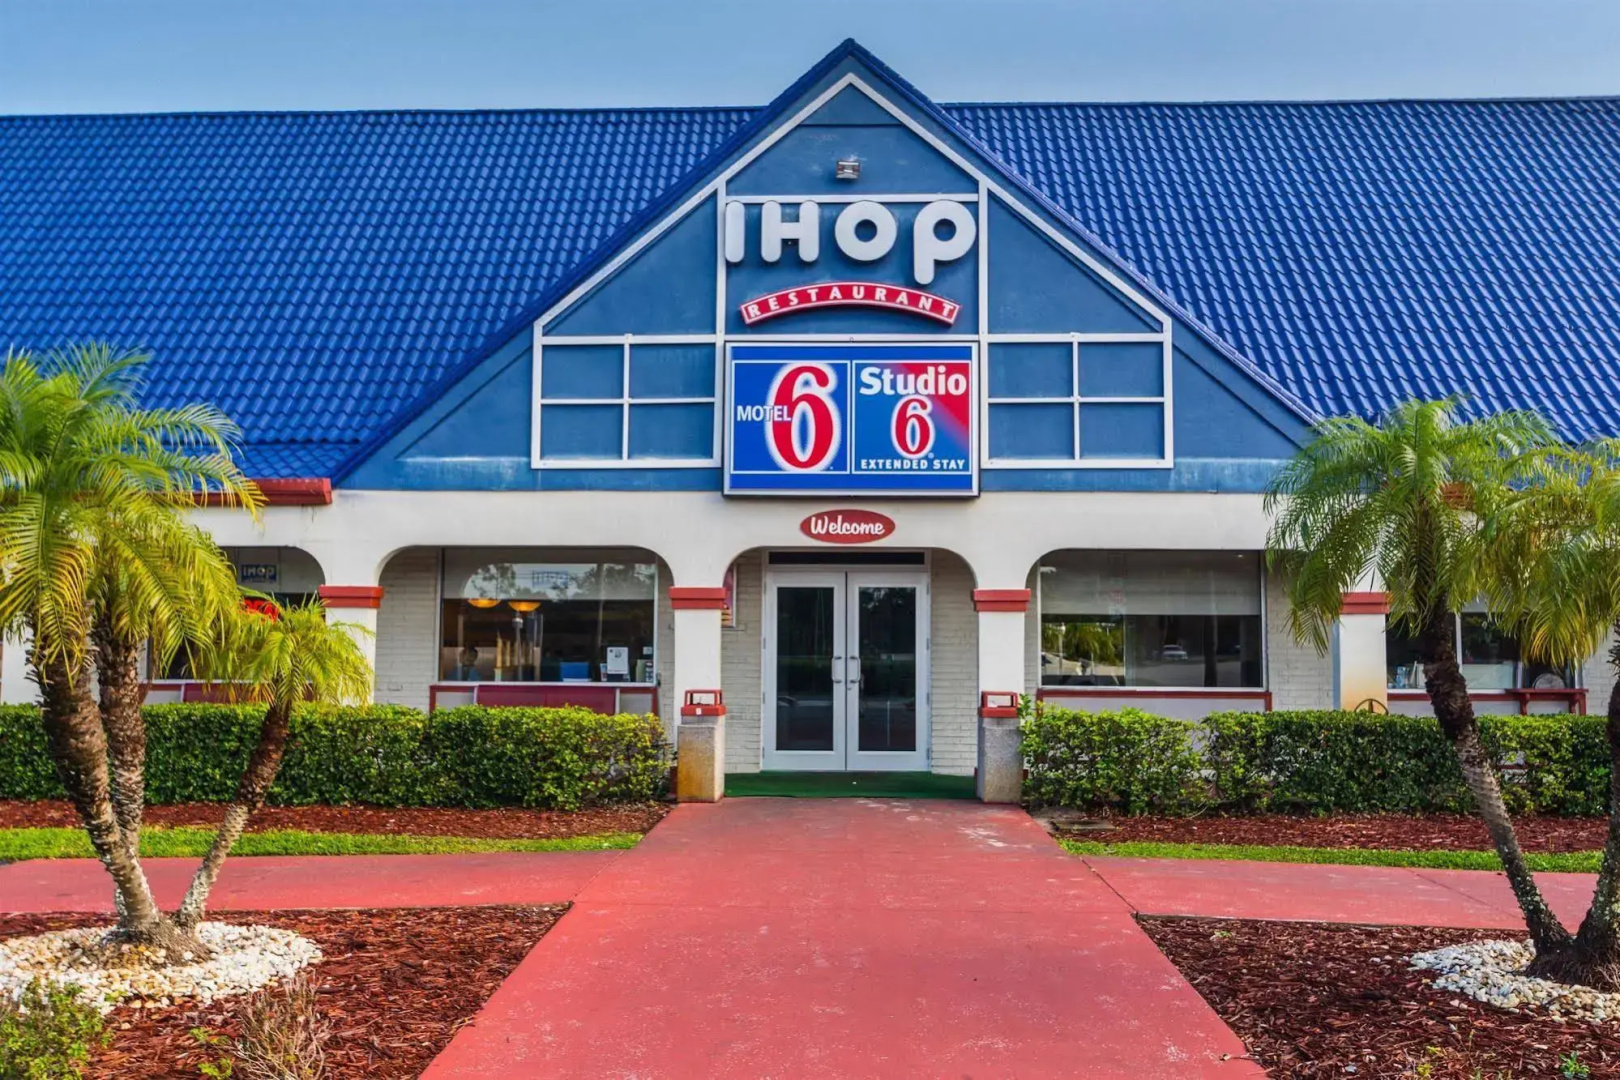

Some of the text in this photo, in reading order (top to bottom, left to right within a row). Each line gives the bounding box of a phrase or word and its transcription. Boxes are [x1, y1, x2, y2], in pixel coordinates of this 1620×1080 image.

[725, 200, 977, 285] IHOP
[747, 285, 955, 319] RESTAURANT
[859, 365, 967, 396] Studio
[736, 364, 837, 470] MOTEL 6
[893, 396, 933, 457] 6
[861, 459, 965, 470] EXTENDED STAY
[810, 515, 885, 536] Welcome
